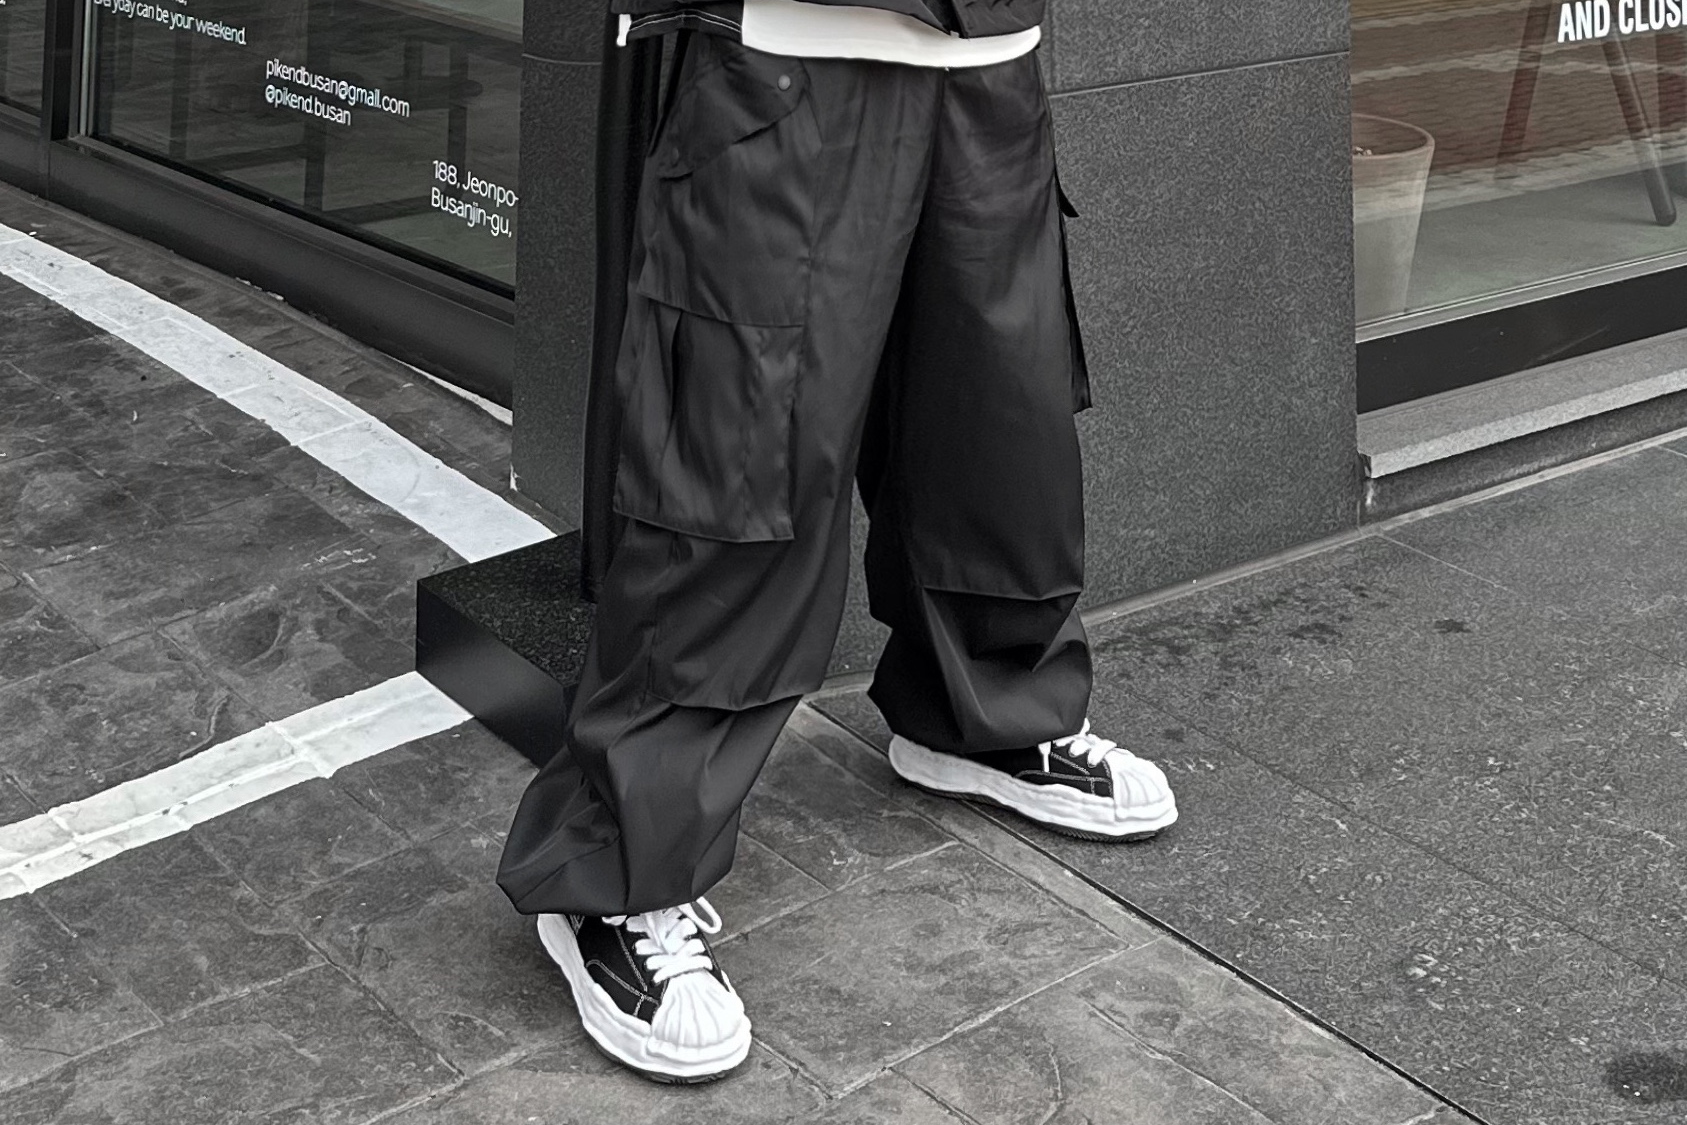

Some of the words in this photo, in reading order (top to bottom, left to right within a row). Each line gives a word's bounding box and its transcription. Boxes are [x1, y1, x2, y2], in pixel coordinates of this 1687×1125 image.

[136, 2, 154, 20] can
[155, 4, 169, 24] be
[169, 11, 195, 30] your
[265, 58, 411, 118] pikendbusan@gmail.com
[432, 159, 461, 189] 188,
[431, 186, 512, 238] Busanjin-gu,
